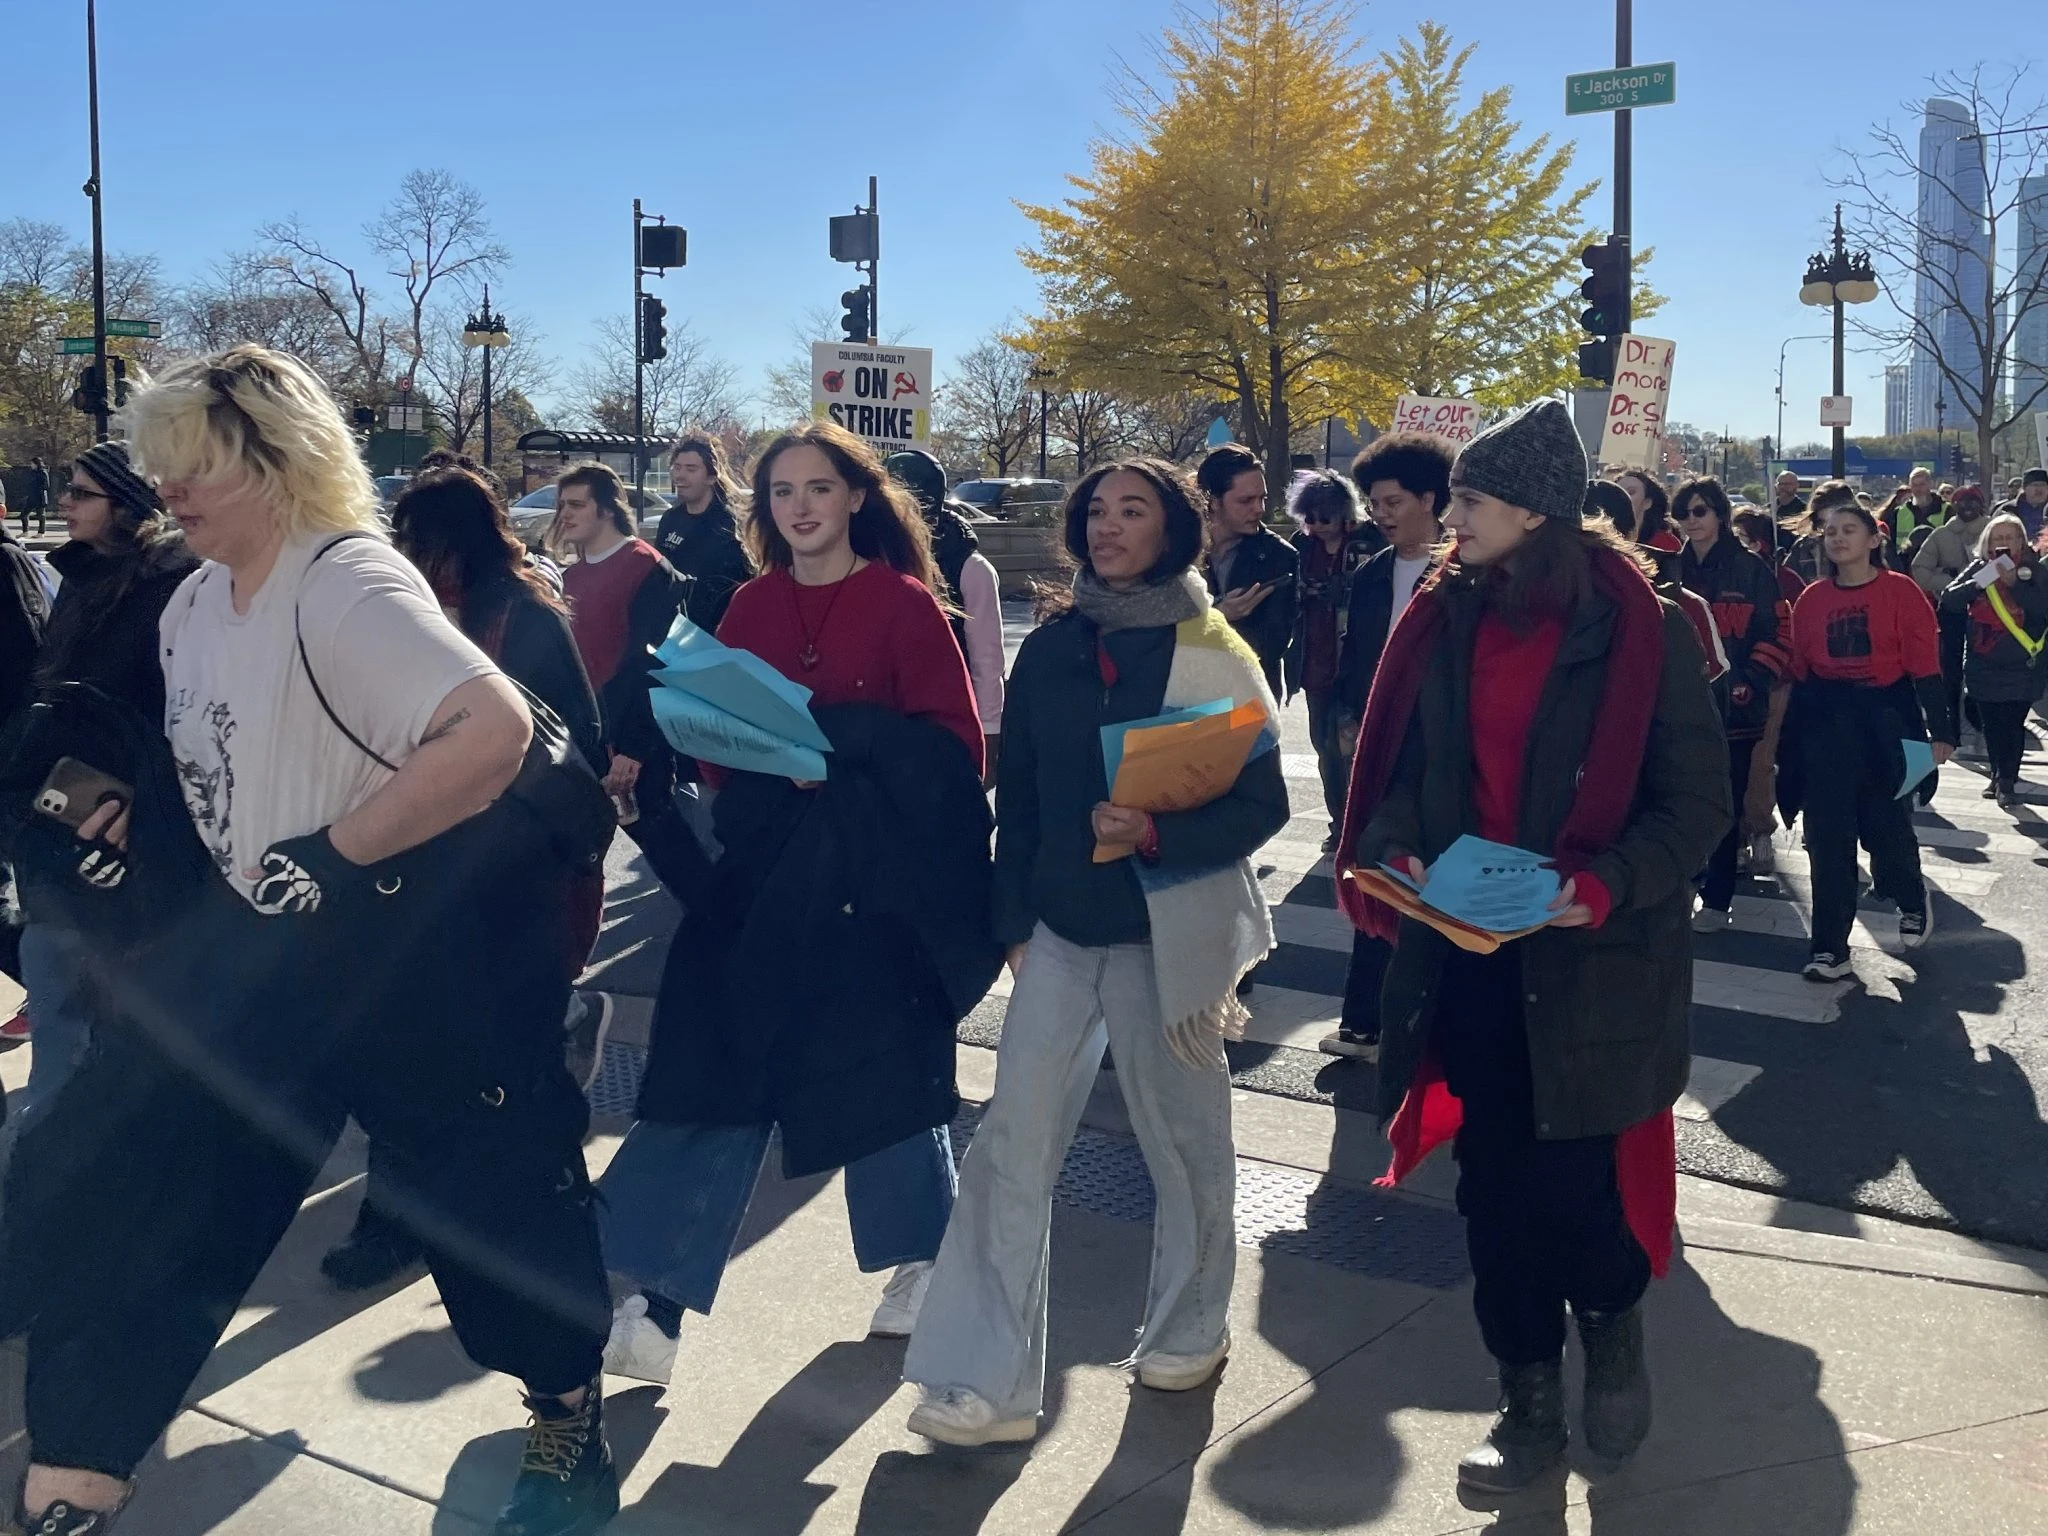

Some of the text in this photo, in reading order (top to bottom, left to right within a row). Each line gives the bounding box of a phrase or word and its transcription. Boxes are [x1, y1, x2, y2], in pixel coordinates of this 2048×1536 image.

[1584, 75, 1648, 94] Jackson
[1600, 90, 1639, 106] 300 S
[876, 353, 906, 364] FACULTY
[1627, 340, 1656, 365] Dr.
[855, 367, 888, 399] ON
[1399, 400, 1431, 420] Let
[1610, 394, 1639, 417] Dr.
[829, 403, 912, 440] STRIKE
